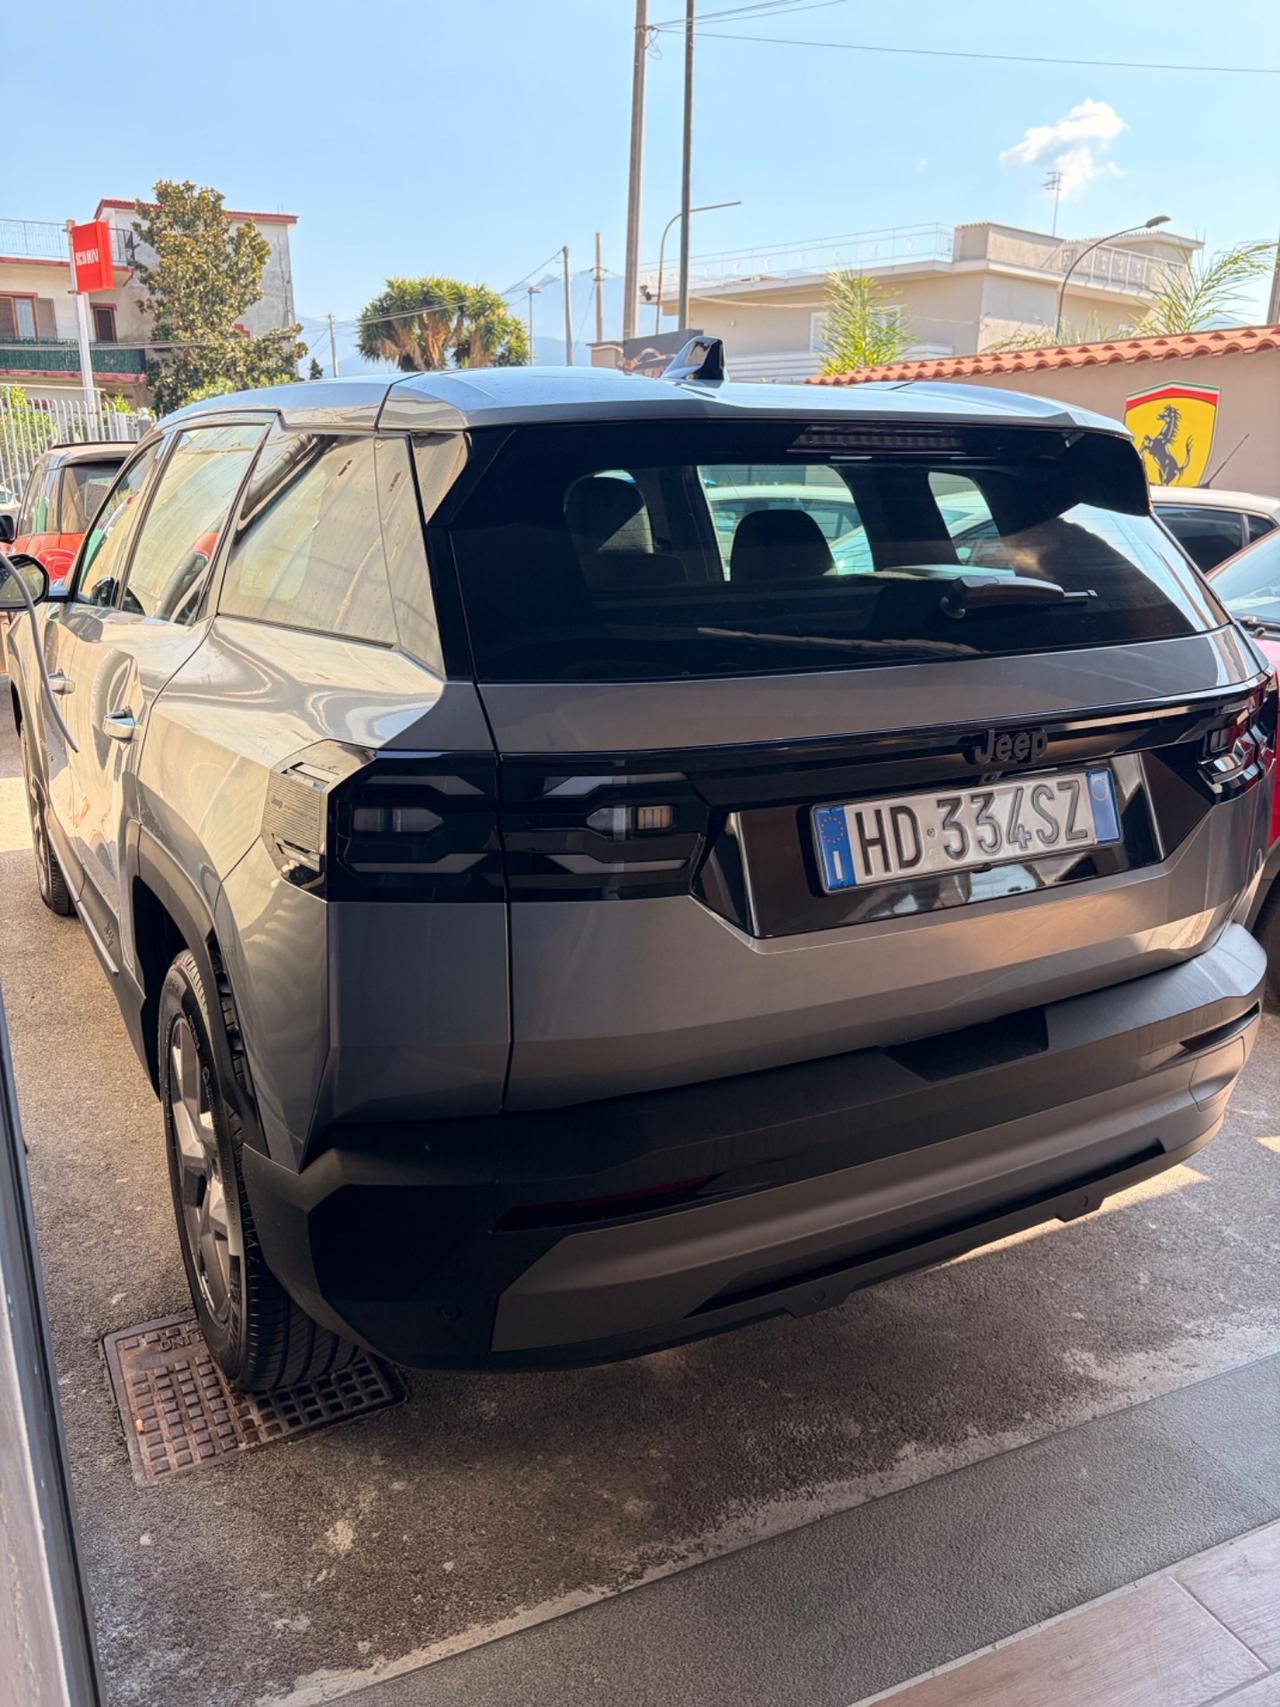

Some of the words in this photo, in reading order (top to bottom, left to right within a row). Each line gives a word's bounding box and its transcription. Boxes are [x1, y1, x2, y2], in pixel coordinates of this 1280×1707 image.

[974, 727, 1048, 764] Jeep
[855, 805, 924, 876] HD
[936, 779, 1089, 860] 334SZ
